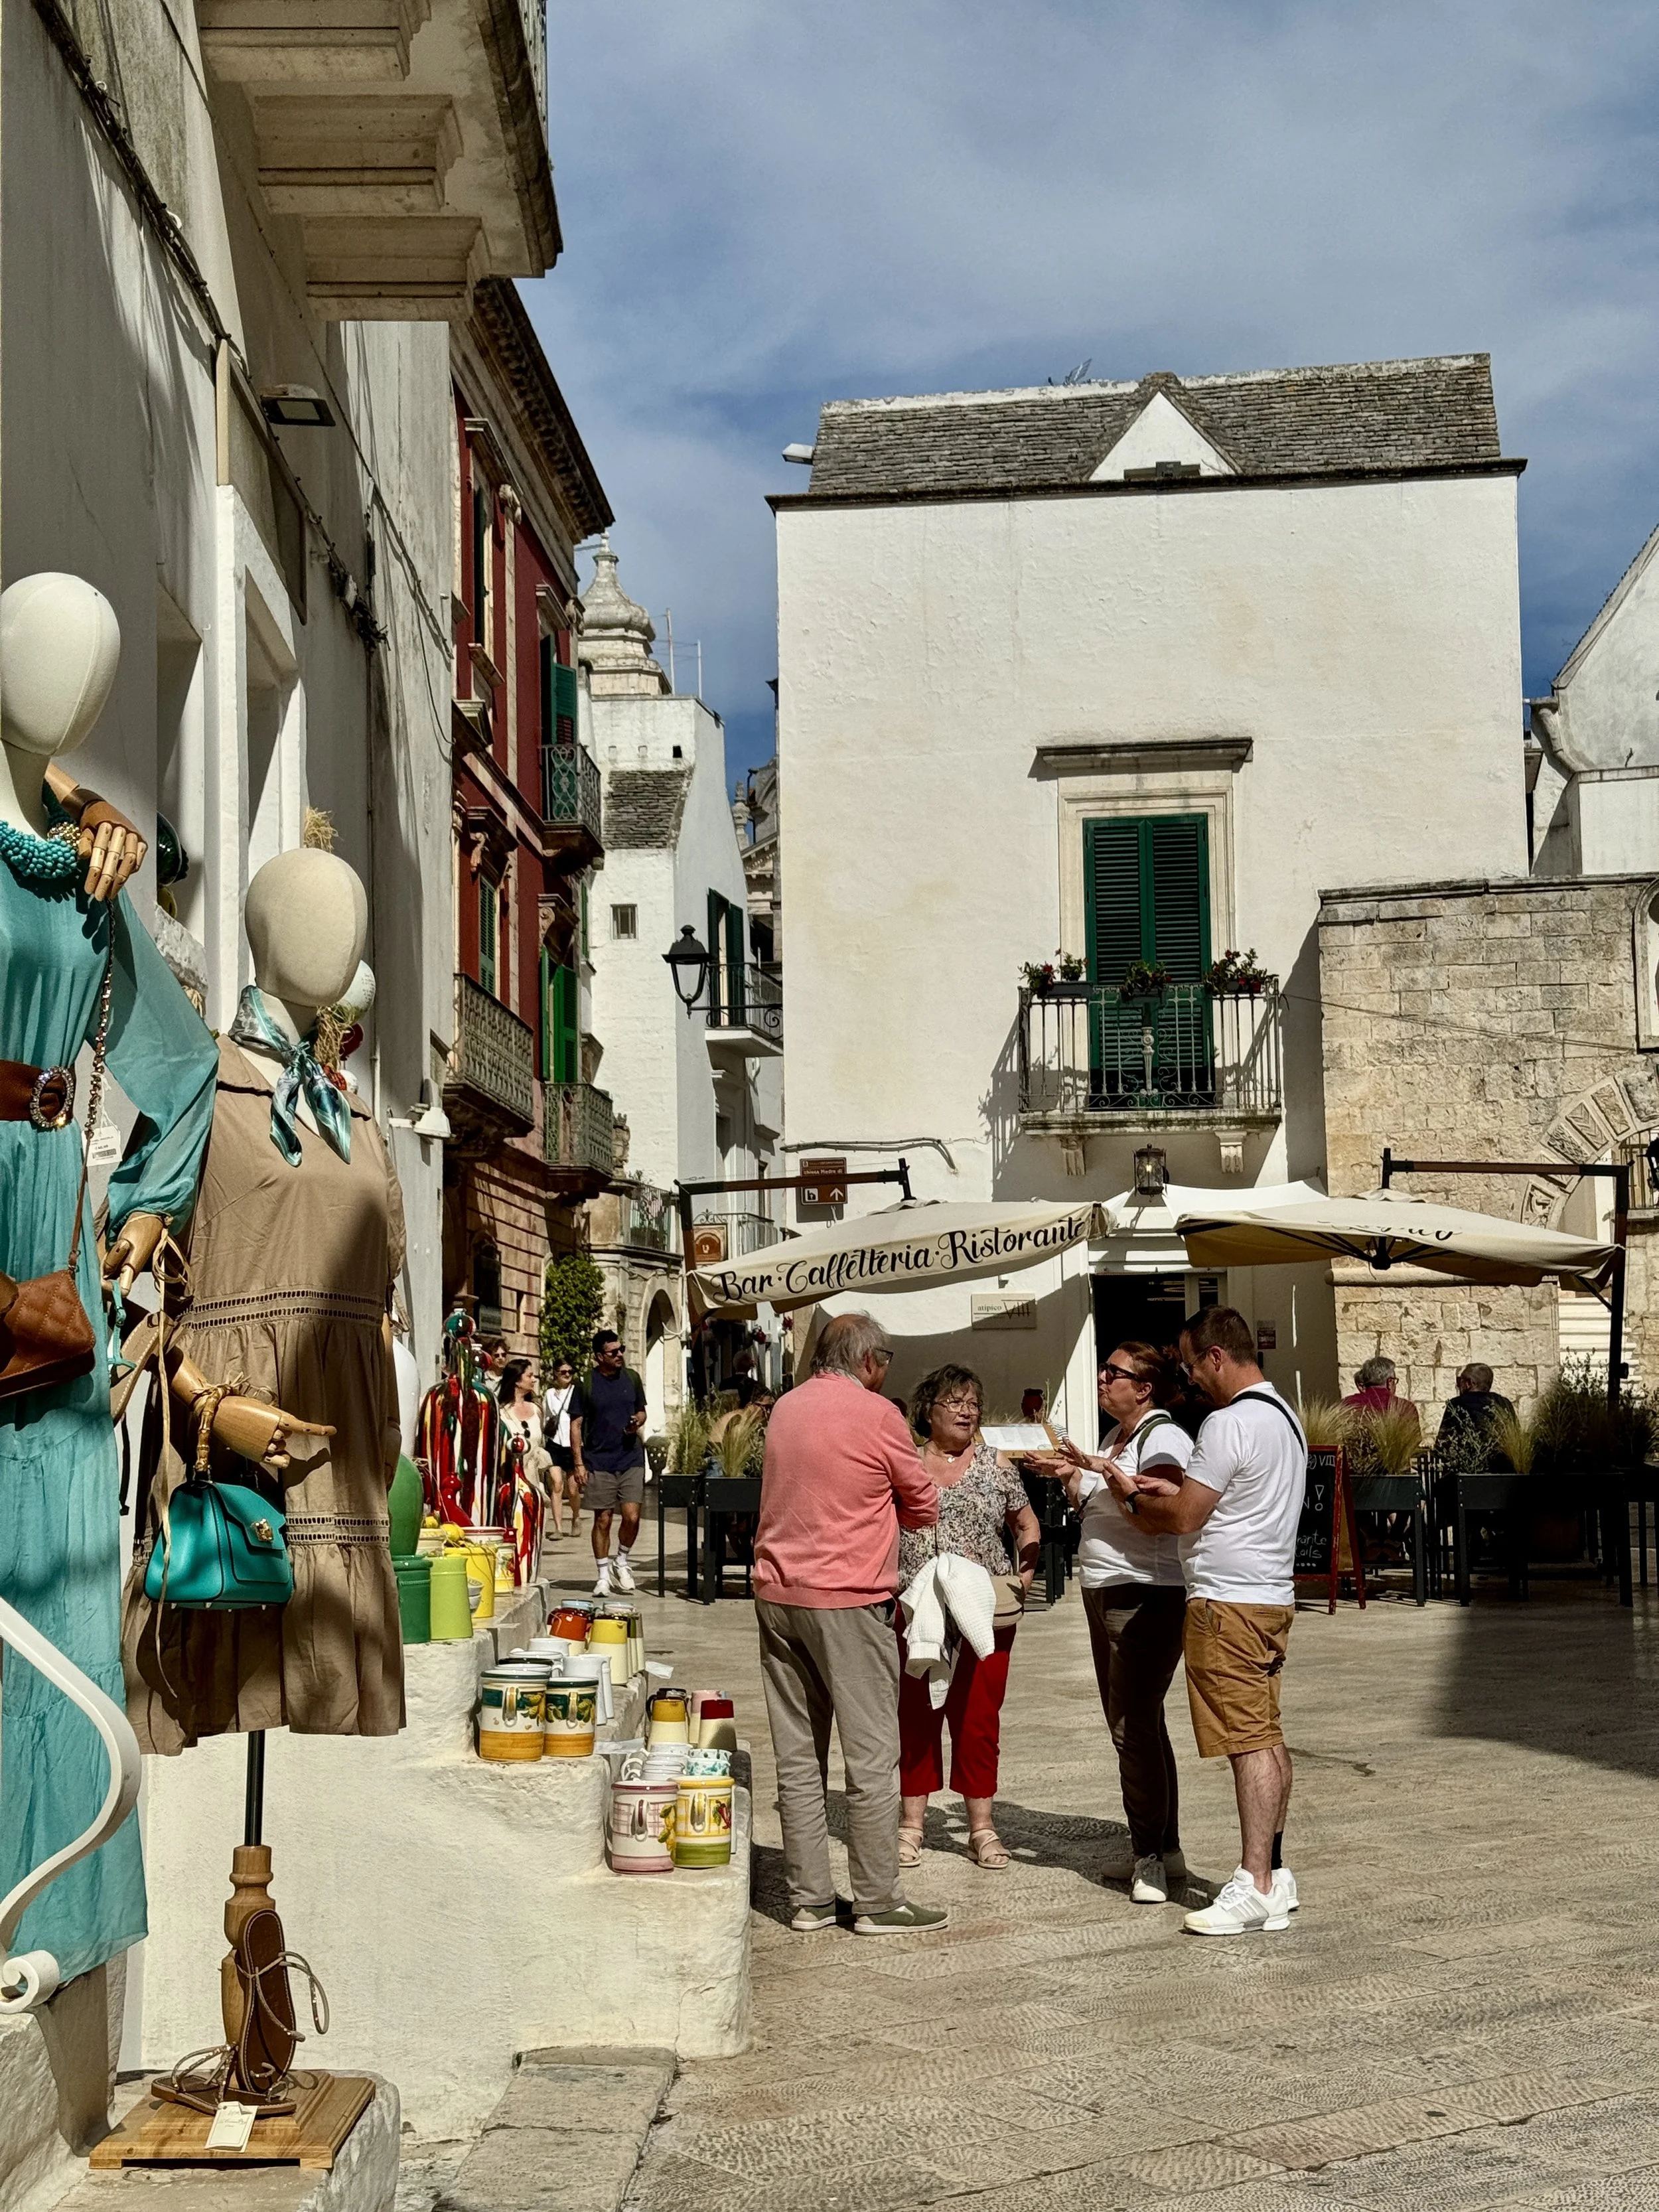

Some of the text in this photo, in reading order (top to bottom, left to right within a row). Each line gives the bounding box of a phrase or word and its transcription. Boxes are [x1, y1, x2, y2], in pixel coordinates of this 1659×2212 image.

[711, 1270, 774, 1302] Bar
[776, 1244, 934, 1293] Caffetteria
[1002, 1299, 1031, 1319] VIII
[1297, 1529, 1327, 1546] rante
